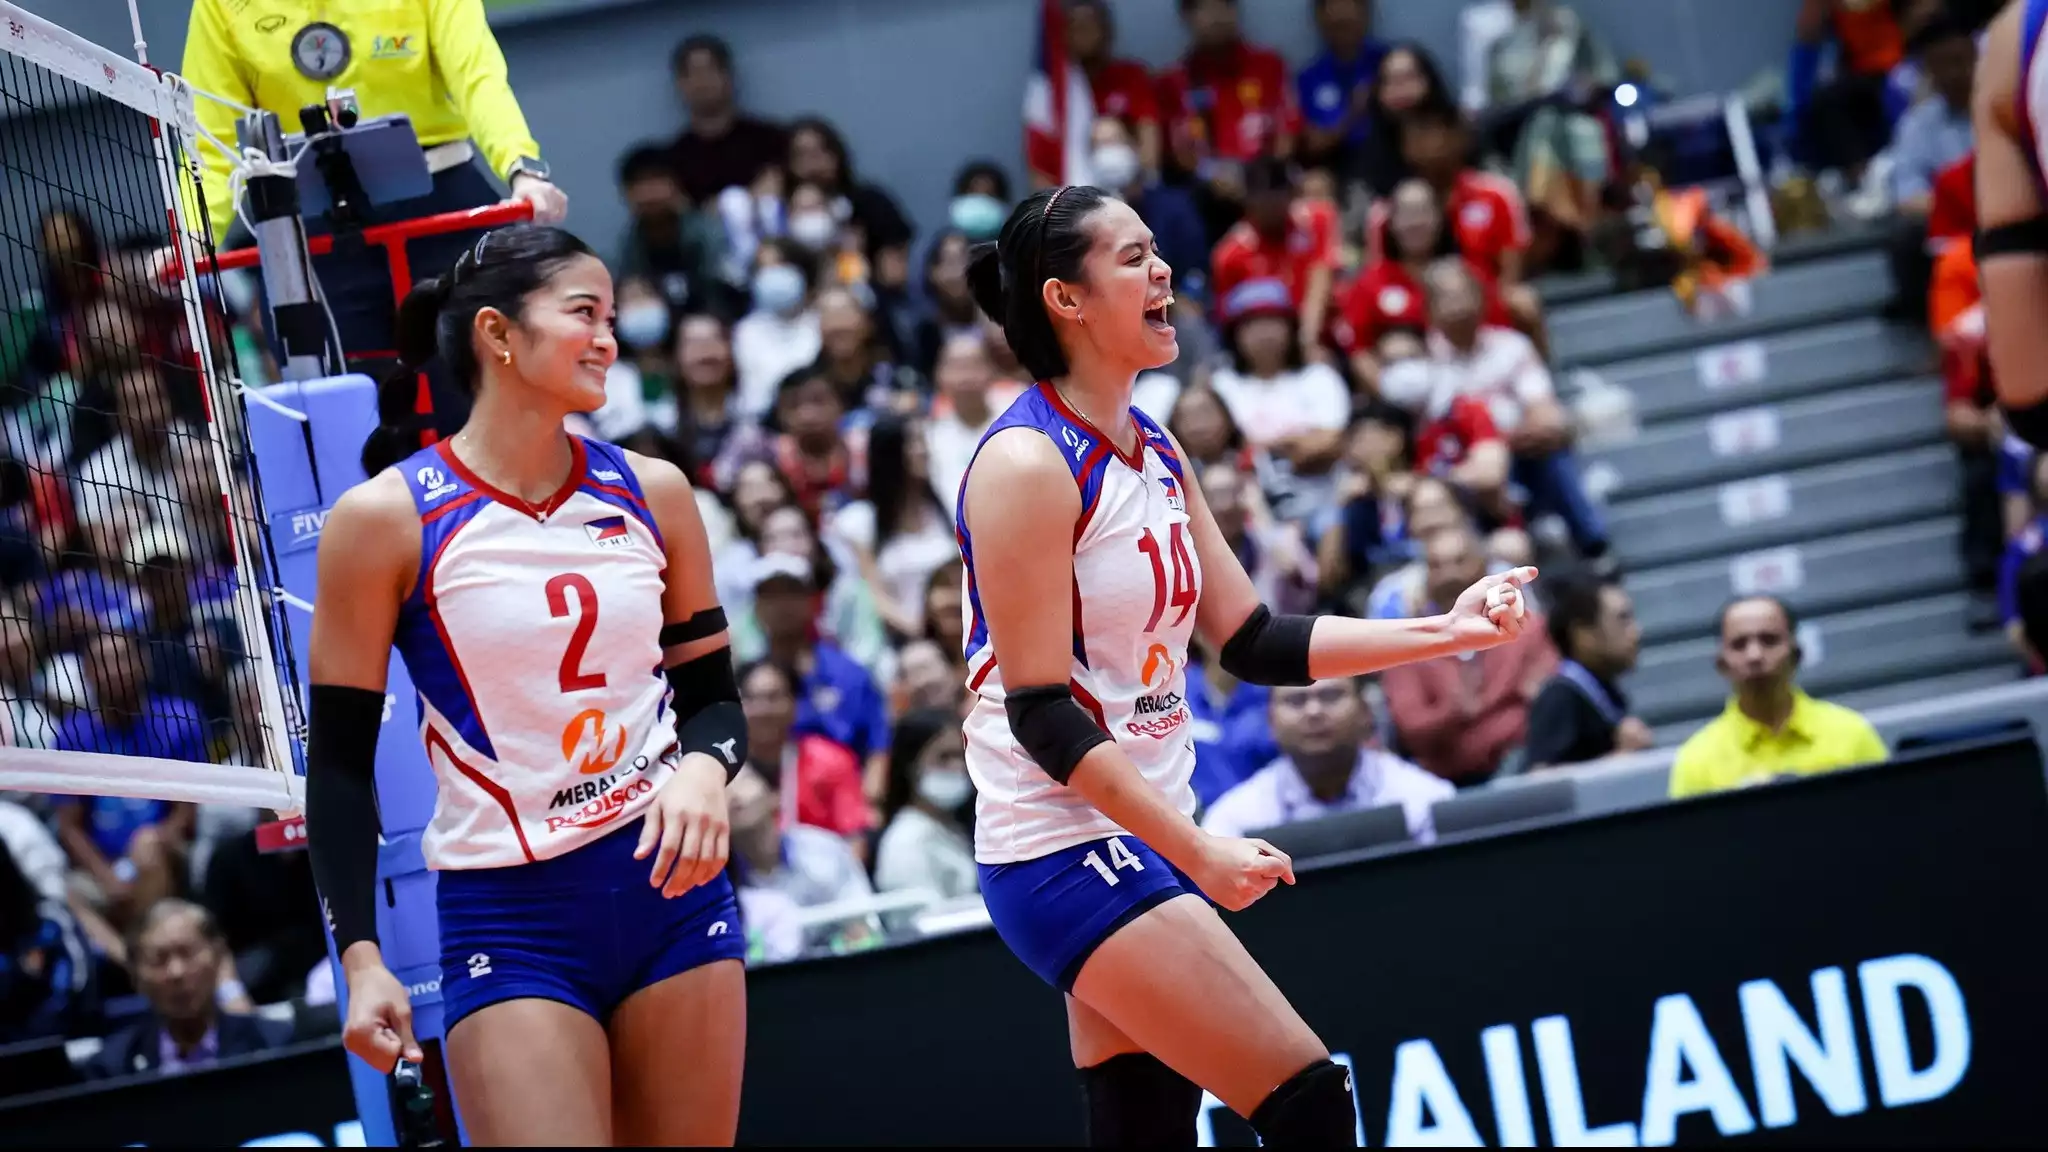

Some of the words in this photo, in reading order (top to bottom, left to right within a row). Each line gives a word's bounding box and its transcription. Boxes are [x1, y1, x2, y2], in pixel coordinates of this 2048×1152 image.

[291, 510, 331, 535] FIV
[598, 536, 629, 548] PHI
[1137, 522, 1198, 632] 14
[545, 572, 607, 693] 2
[1082, 836, 1145, 887] 14
[466, 952, 493, 979] 2
[1196, 953, 1973, 1147] AILAND
